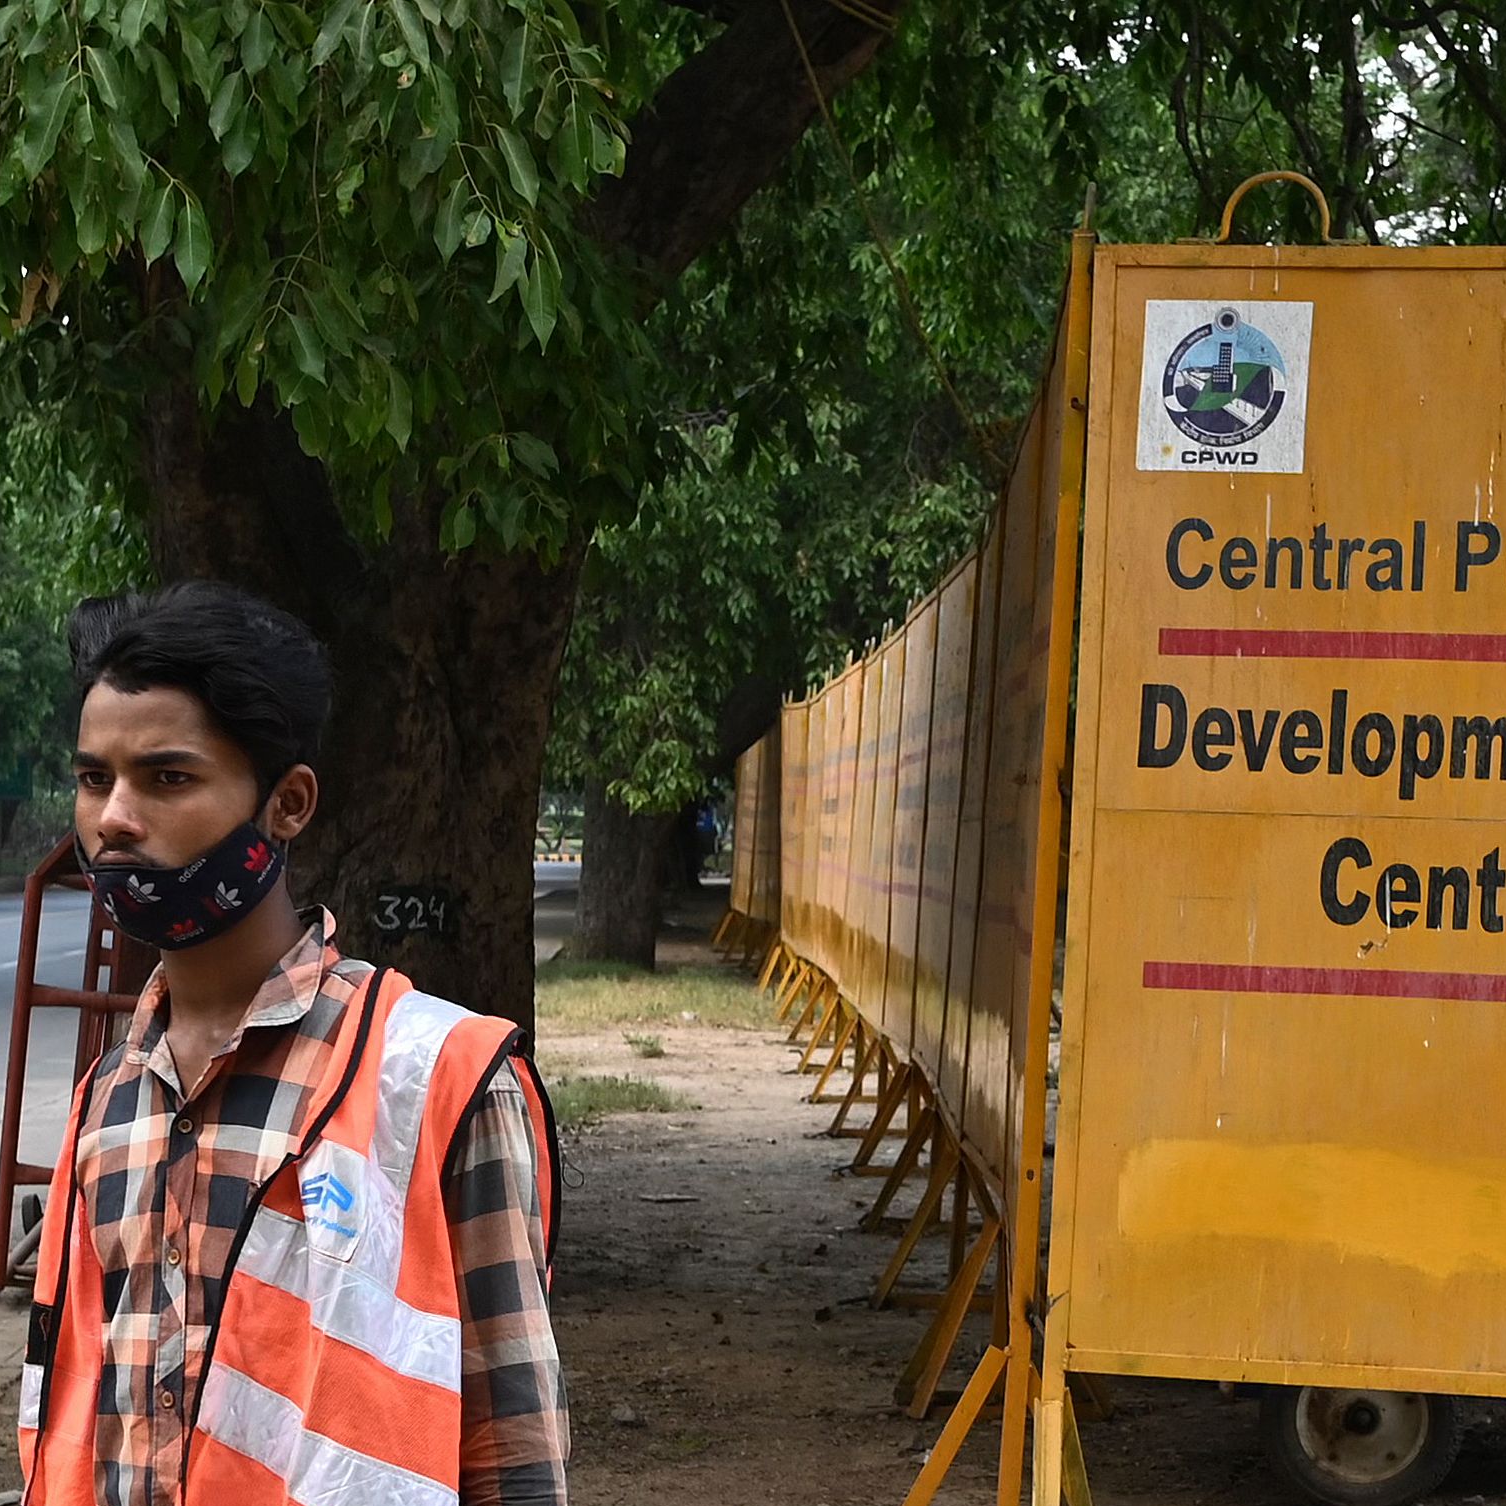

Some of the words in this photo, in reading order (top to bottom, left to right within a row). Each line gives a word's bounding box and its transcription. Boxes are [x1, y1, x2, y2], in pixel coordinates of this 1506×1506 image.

[1180, 450, 1259, 466] CPWD
[1165, 517, 1426, 592] Central
[178, 857, 207, 883] adidas
[374, 895, 445, 931] 324
